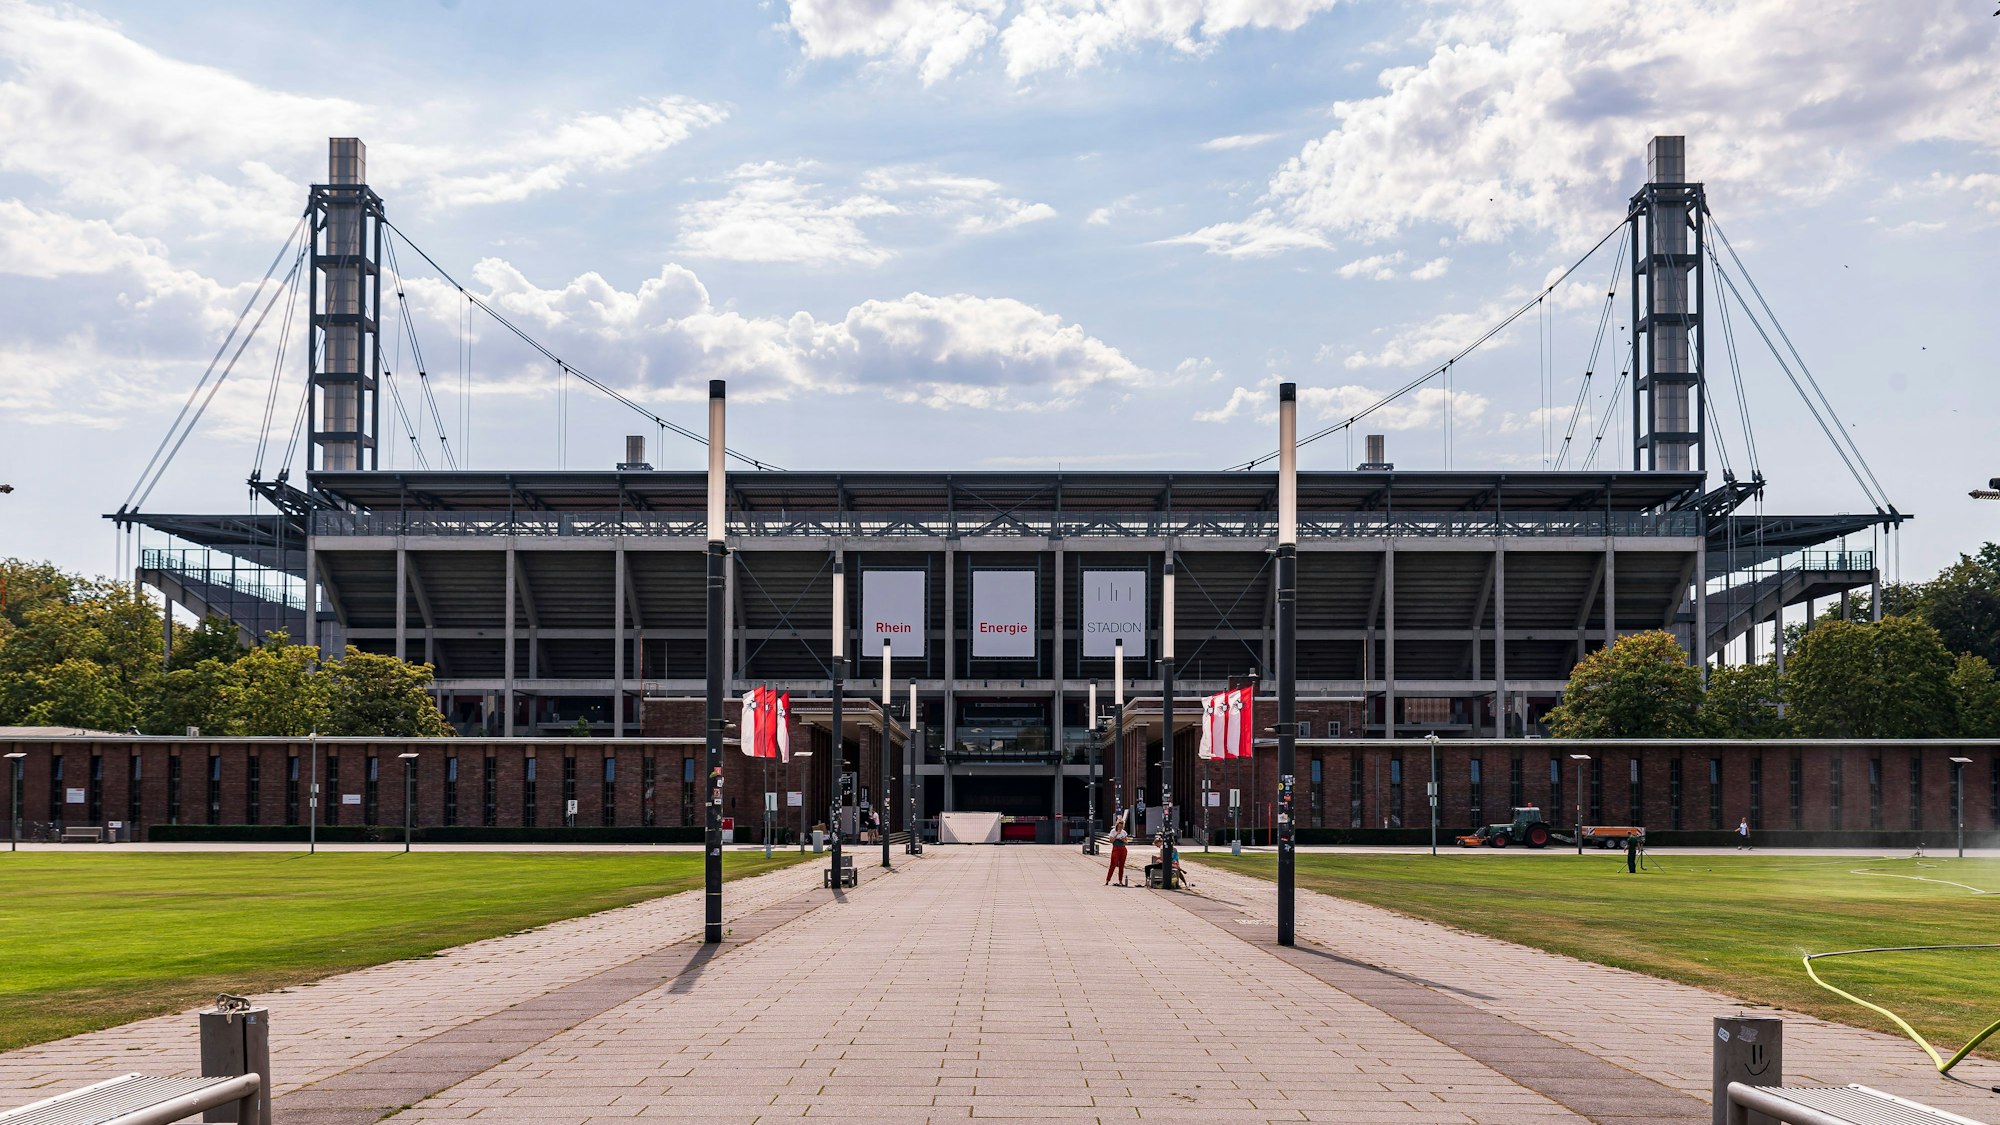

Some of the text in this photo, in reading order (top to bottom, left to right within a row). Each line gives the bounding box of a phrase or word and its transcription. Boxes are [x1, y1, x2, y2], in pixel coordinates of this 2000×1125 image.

[876, 622, 911, 633] Rhein
[980, 622, 1028, 635] Energie
[1087, 622, 1141, 633] STADION
